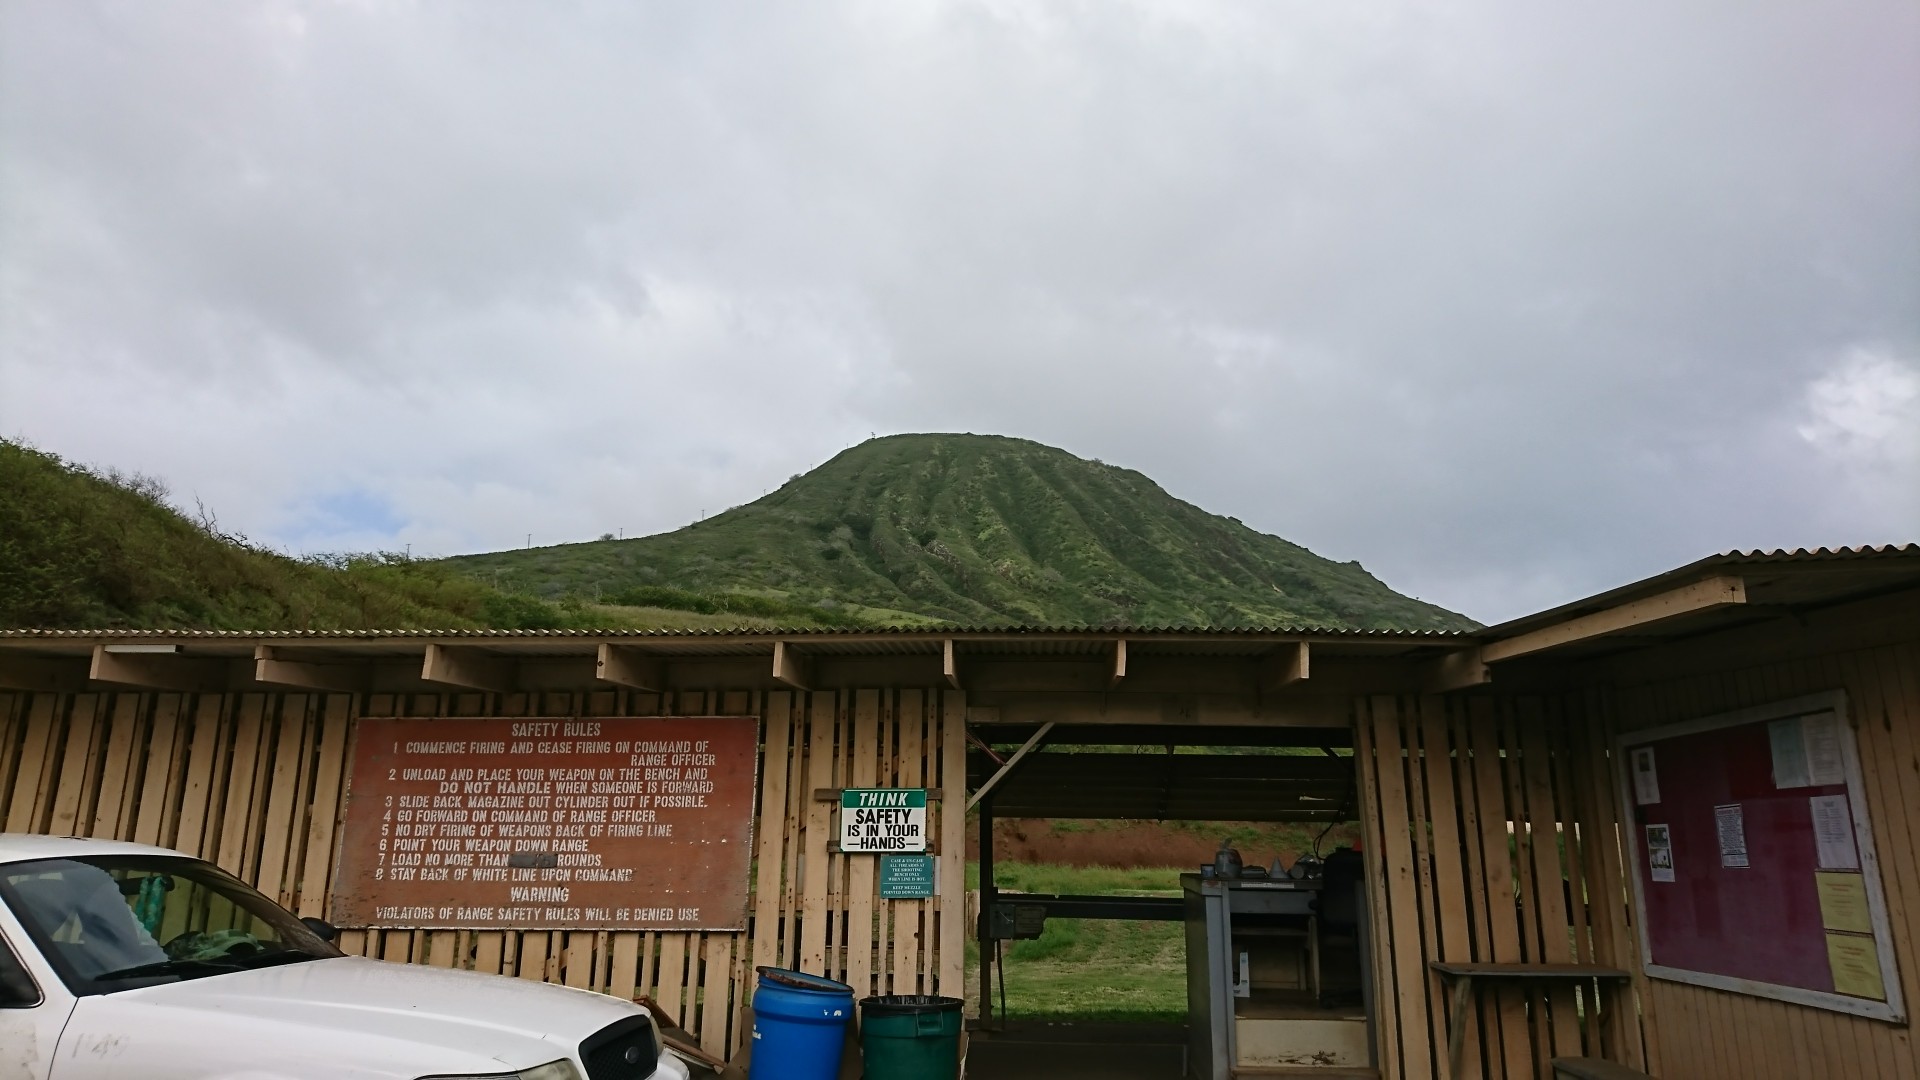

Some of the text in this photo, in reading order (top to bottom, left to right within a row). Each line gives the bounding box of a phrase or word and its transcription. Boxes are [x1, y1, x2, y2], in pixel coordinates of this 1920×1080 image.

[512, 723, 600, 736] SAFETY RULES
[406, 742, 466, 753] COMMENCE
[470, 742, 505, 753] FIRING
[510, 742, 533, 753] AND
[538, 742, 572, 753] CEASE
[576, 742, 611, 753] FIRING
[616, 742, 630, 753] ON
[635, 741, 691, 754] COMMAND
[696, 741, 709, 754] OF
[631, 754, 715, 766] RANGE OFFICER
[403, 769, 446, 780] UNLOAD
[450, 769, 473, 780] AND
[478, 769, 511, 780] PLACE
[517, 769, 544, 780] YOUR
[550, 769, 595, 780] WEAPON
[600, 769, 614, 780] ON
[619, 768, 640, 780] THE
[645, 768, 680, 781] BENCH
[685, 768, 708, 781] AND
[440, 781, 713, 793] DO NOT HANDLE WHEN SOMEONE IS FORWARD
[400, 796, 429, 807] SLIDE
[434, 796, 462, 807] BACK
[468, 796, 524, 807] MAGAZINE
[529, 796, 551, 808] OUT
[556, 796, 608, 808] CYLINDER
[613, 796, 635, 807] OUT
[640, 796, 650, 807] IF
[860, 792, 908, 806] THINK
[398, 810, 412, 821] GO
[416, 810, 467, 822] FORWARD
[472, 810, 487, 822] ON
[491, 811, 548, 822] COMMAND
[553, 810, 566, 822] OF
[571, 810, 607, 822] RANGE
[855, 809, 912, 824] SAFETY
[396, 824, 410, 836] NO
[415, 824, 436, 836] DRY
[440, 825, 475, 836] FIRING
[480, 825, 494, 836] OF
[499, 825, 551, 836] WEAPONS
[556, 825, 585, 837] BACK
[590, 825, 603, 836] OF
[608, 825, 643, 837] FIRING
[847, 825, 919, 837] IS IN YOUR
[394, 839, 426, 851] POINT
[432, 839, 460, 851] YOUR
[466, 839, 511, 851] WEAPON
[515, 840, 548, 851] DOWN
[860, 837, 905, 850] HANDS
[392, 853, 421, 865] LOAD
[425, 854, 440, 865] NO
[445, 854, 474, 866] MORE
[479, 854, 508, 866] THAN
[391, 868, 416, 880] STAY
[421, 868, 448, 880] BACK
[454, 868, 468, 880] OF
[473, 869, 508, 881] WHITE
[512, 869, 537, 881] LINE
[542, 869, 570, 881] UPON
[511, 887, 569, 902] WARNING
[377, 907, 434, 919] VIOLATORS
[439, 907, 453, 919] OF
[457, 907, 493, 920] RANGE
[498, 908, 541, 920] SAFETY
[546, 908, 580, 920] RULES
[586, 908, 611, 920] WILL
[617, 908, 629, 920] BE
[634, 908, 673, 920] DENIED
